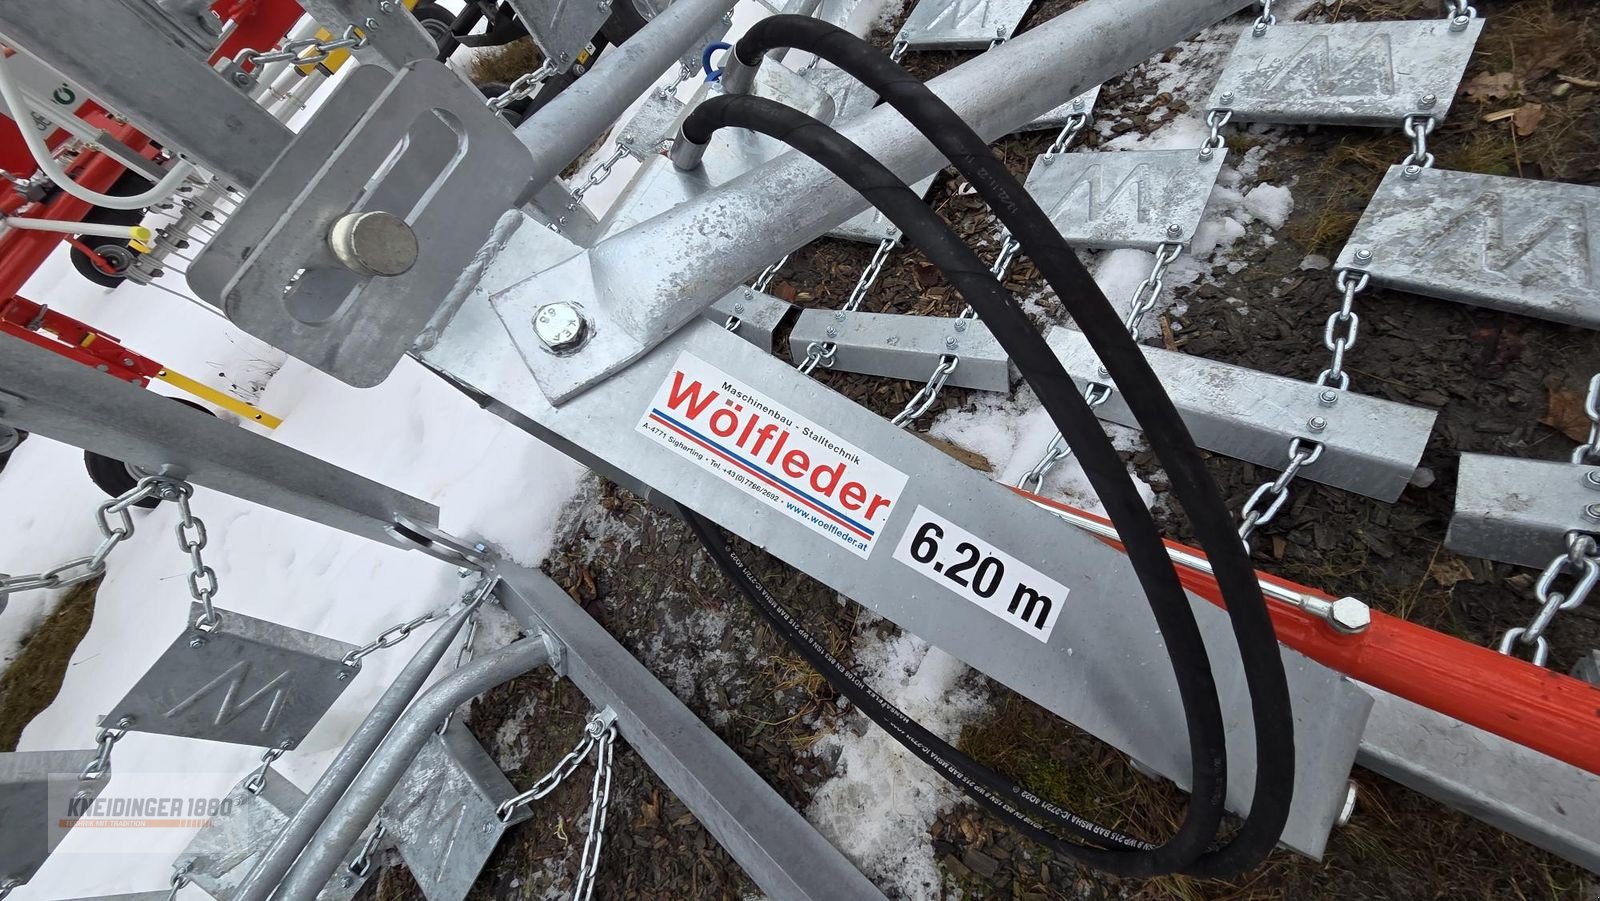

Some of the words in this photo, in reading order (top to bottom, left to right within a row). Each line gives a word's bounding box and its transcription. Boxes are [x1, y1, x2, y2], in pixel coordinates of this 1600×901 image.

[721, 381, 793, 427] Maschinenbau
[802, 426, 861, 465] Stalltechnik
[666, 370, 891, 521] Wölfleder
[642, 422, 667, 439] A-4771
[667, 436, 704, 460] Sigharting
[710, 458, 721, 471] Tel.
[785, 500, 868, 553] www.woelfleder.at
[909, 521, 1005, 599] 6.20
[1007, 582, 1053, 631] m
[762, 590, 778, 608] MSHA
[776, 606, 790, 621] BAR
[789, 619, 800, 630] 215
[798, 629, 809, 640] WP
[812, 642, 825, 655] 1SN
[835, 662, 846, 673] EN
[930, 752, 952, 769] MSHA
[948, 766, 964, 780] BAR
[962, 775, 975, 787] 215
[1041, 801, 1073, 822] IC-272/1
[1071, 815, 1097, 833] MSHA
[1093, 826, 1113, 838] BAR
[1110, 832, 1124, 843] 215
[1124, 838, 1138, 847] WP
